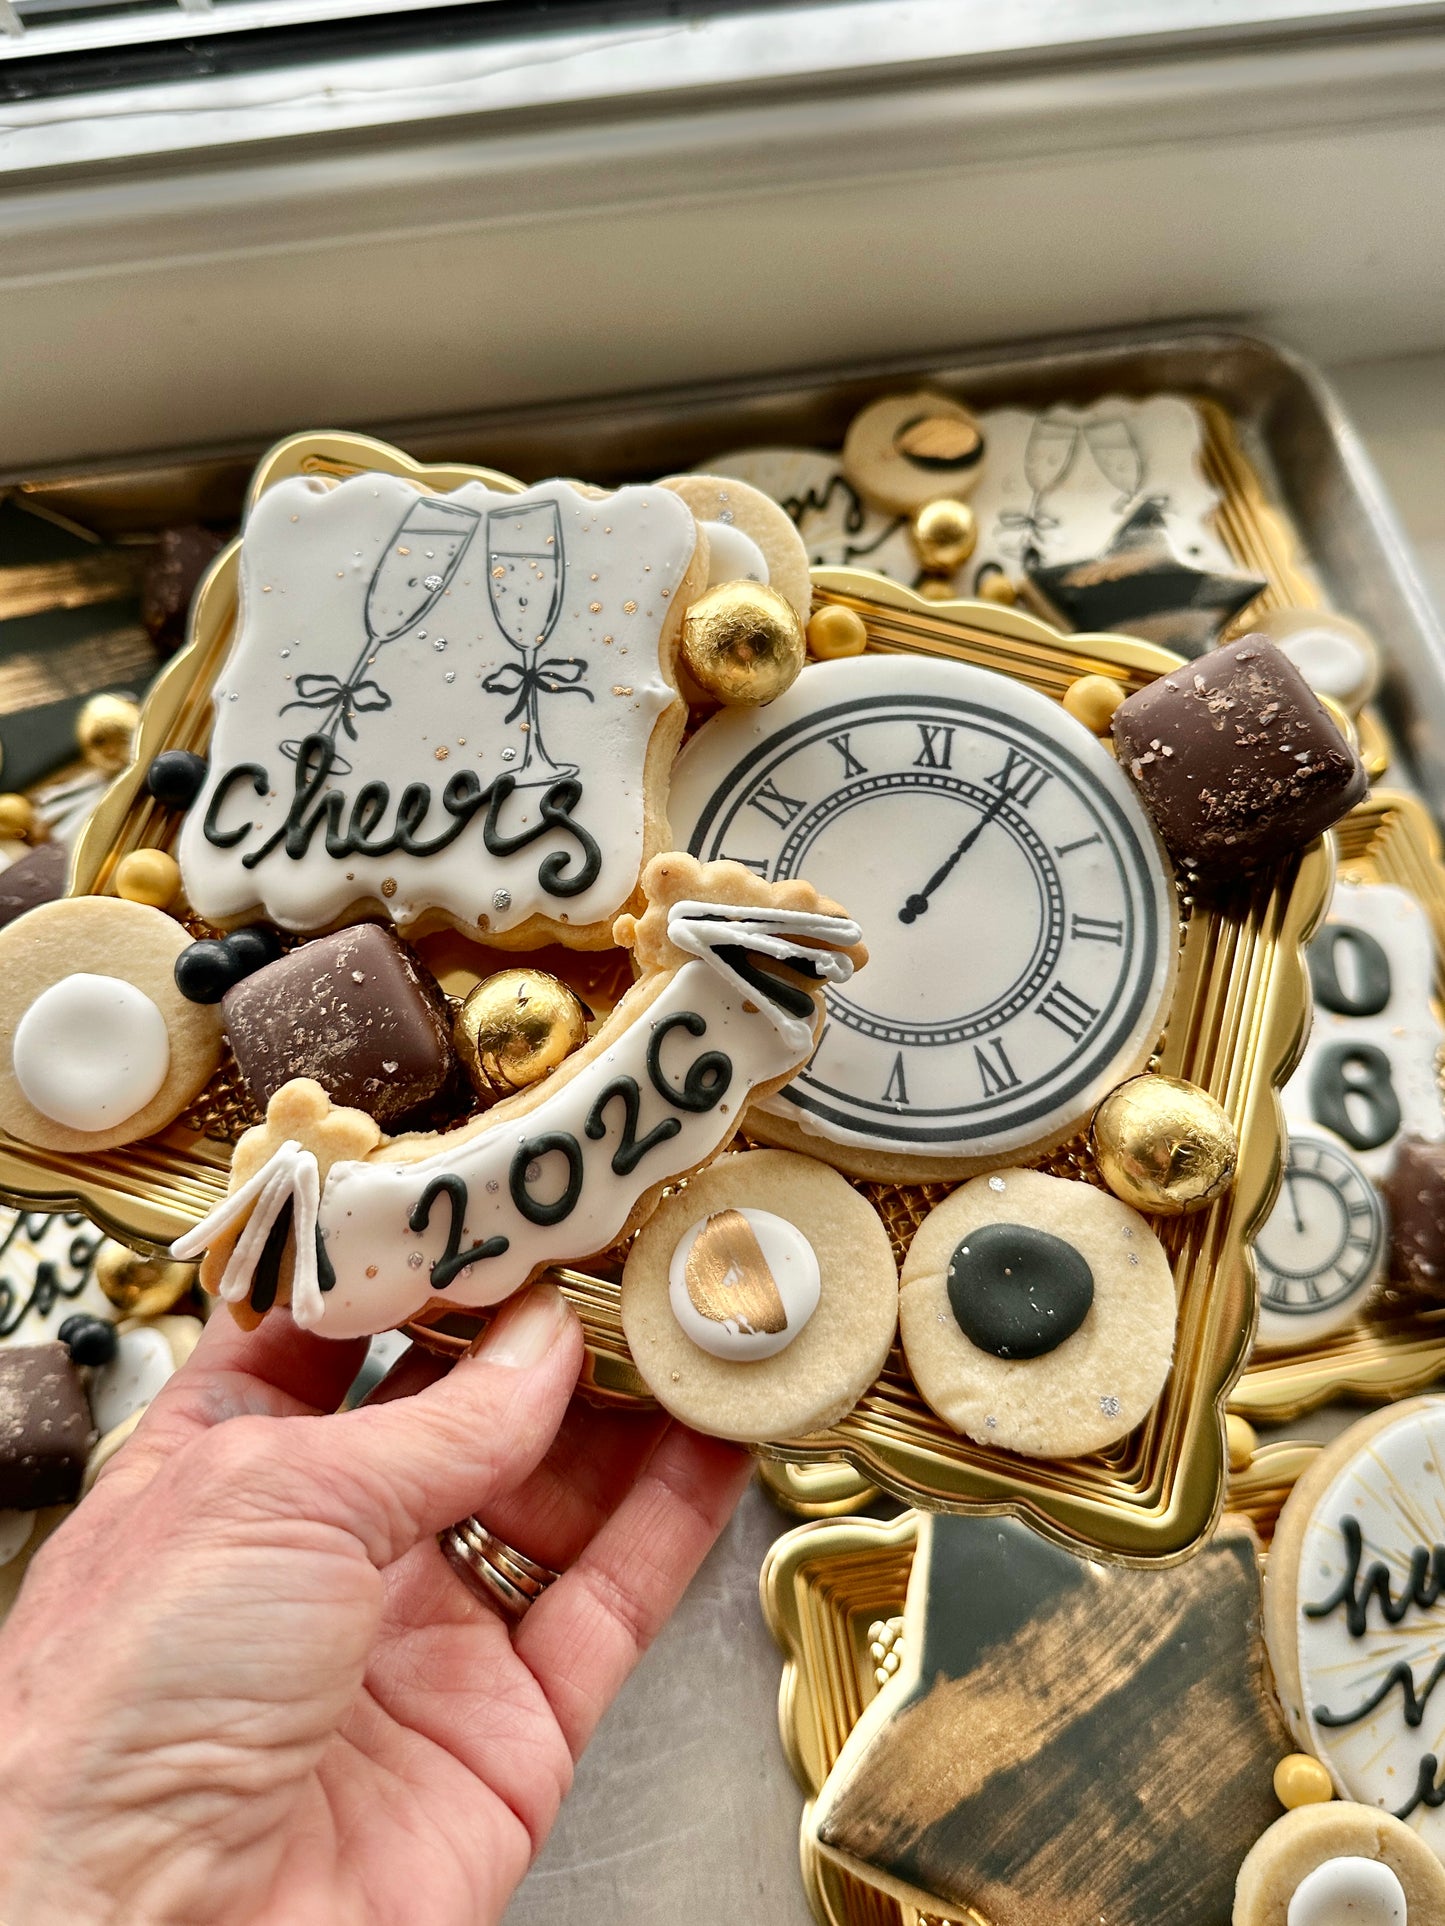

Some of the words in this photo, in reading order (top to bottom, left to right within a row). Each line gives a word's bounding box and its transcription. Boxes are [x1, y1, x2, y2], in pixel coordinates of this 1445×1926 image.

[827, 733, 869, 779] X
[912, 723, 956, 770] XI
[747, 778, 807, 830] IX
[984, 747, 1055, 809] XII
[1055, 832, 1104, 859] I
[1071, 913, 1124, 947] II
[1035, 981, 1100, 1043] III
[881, 1050, 910, 1104] V
[974, 1036, 1022, 1098] IV
[409, 1011, 733, 1289] 2026
